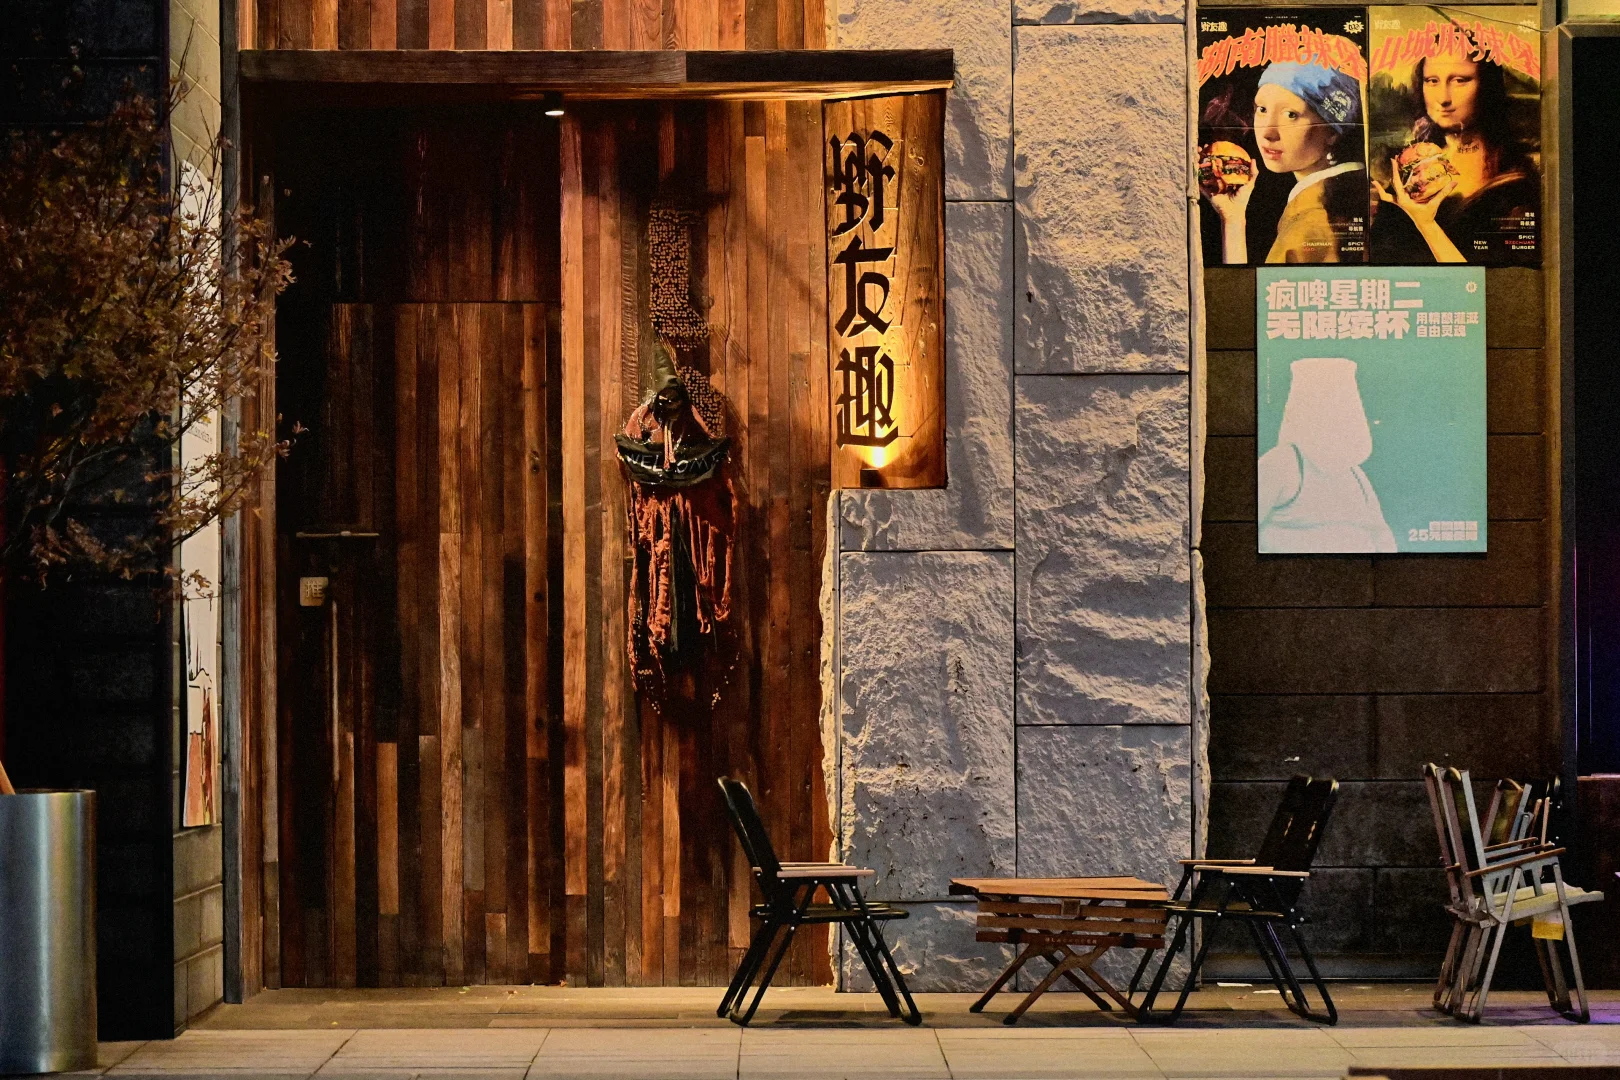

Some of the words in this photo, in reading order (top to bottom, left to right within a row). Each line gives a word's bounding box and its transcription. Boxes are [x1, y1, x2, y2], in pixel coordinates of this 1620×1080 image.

[1265, 279, 1424, 310] 疯啤星期二
[1265, 311, 1411, 340] 无限续杯
[626, 451, 724, 475] WELOME
